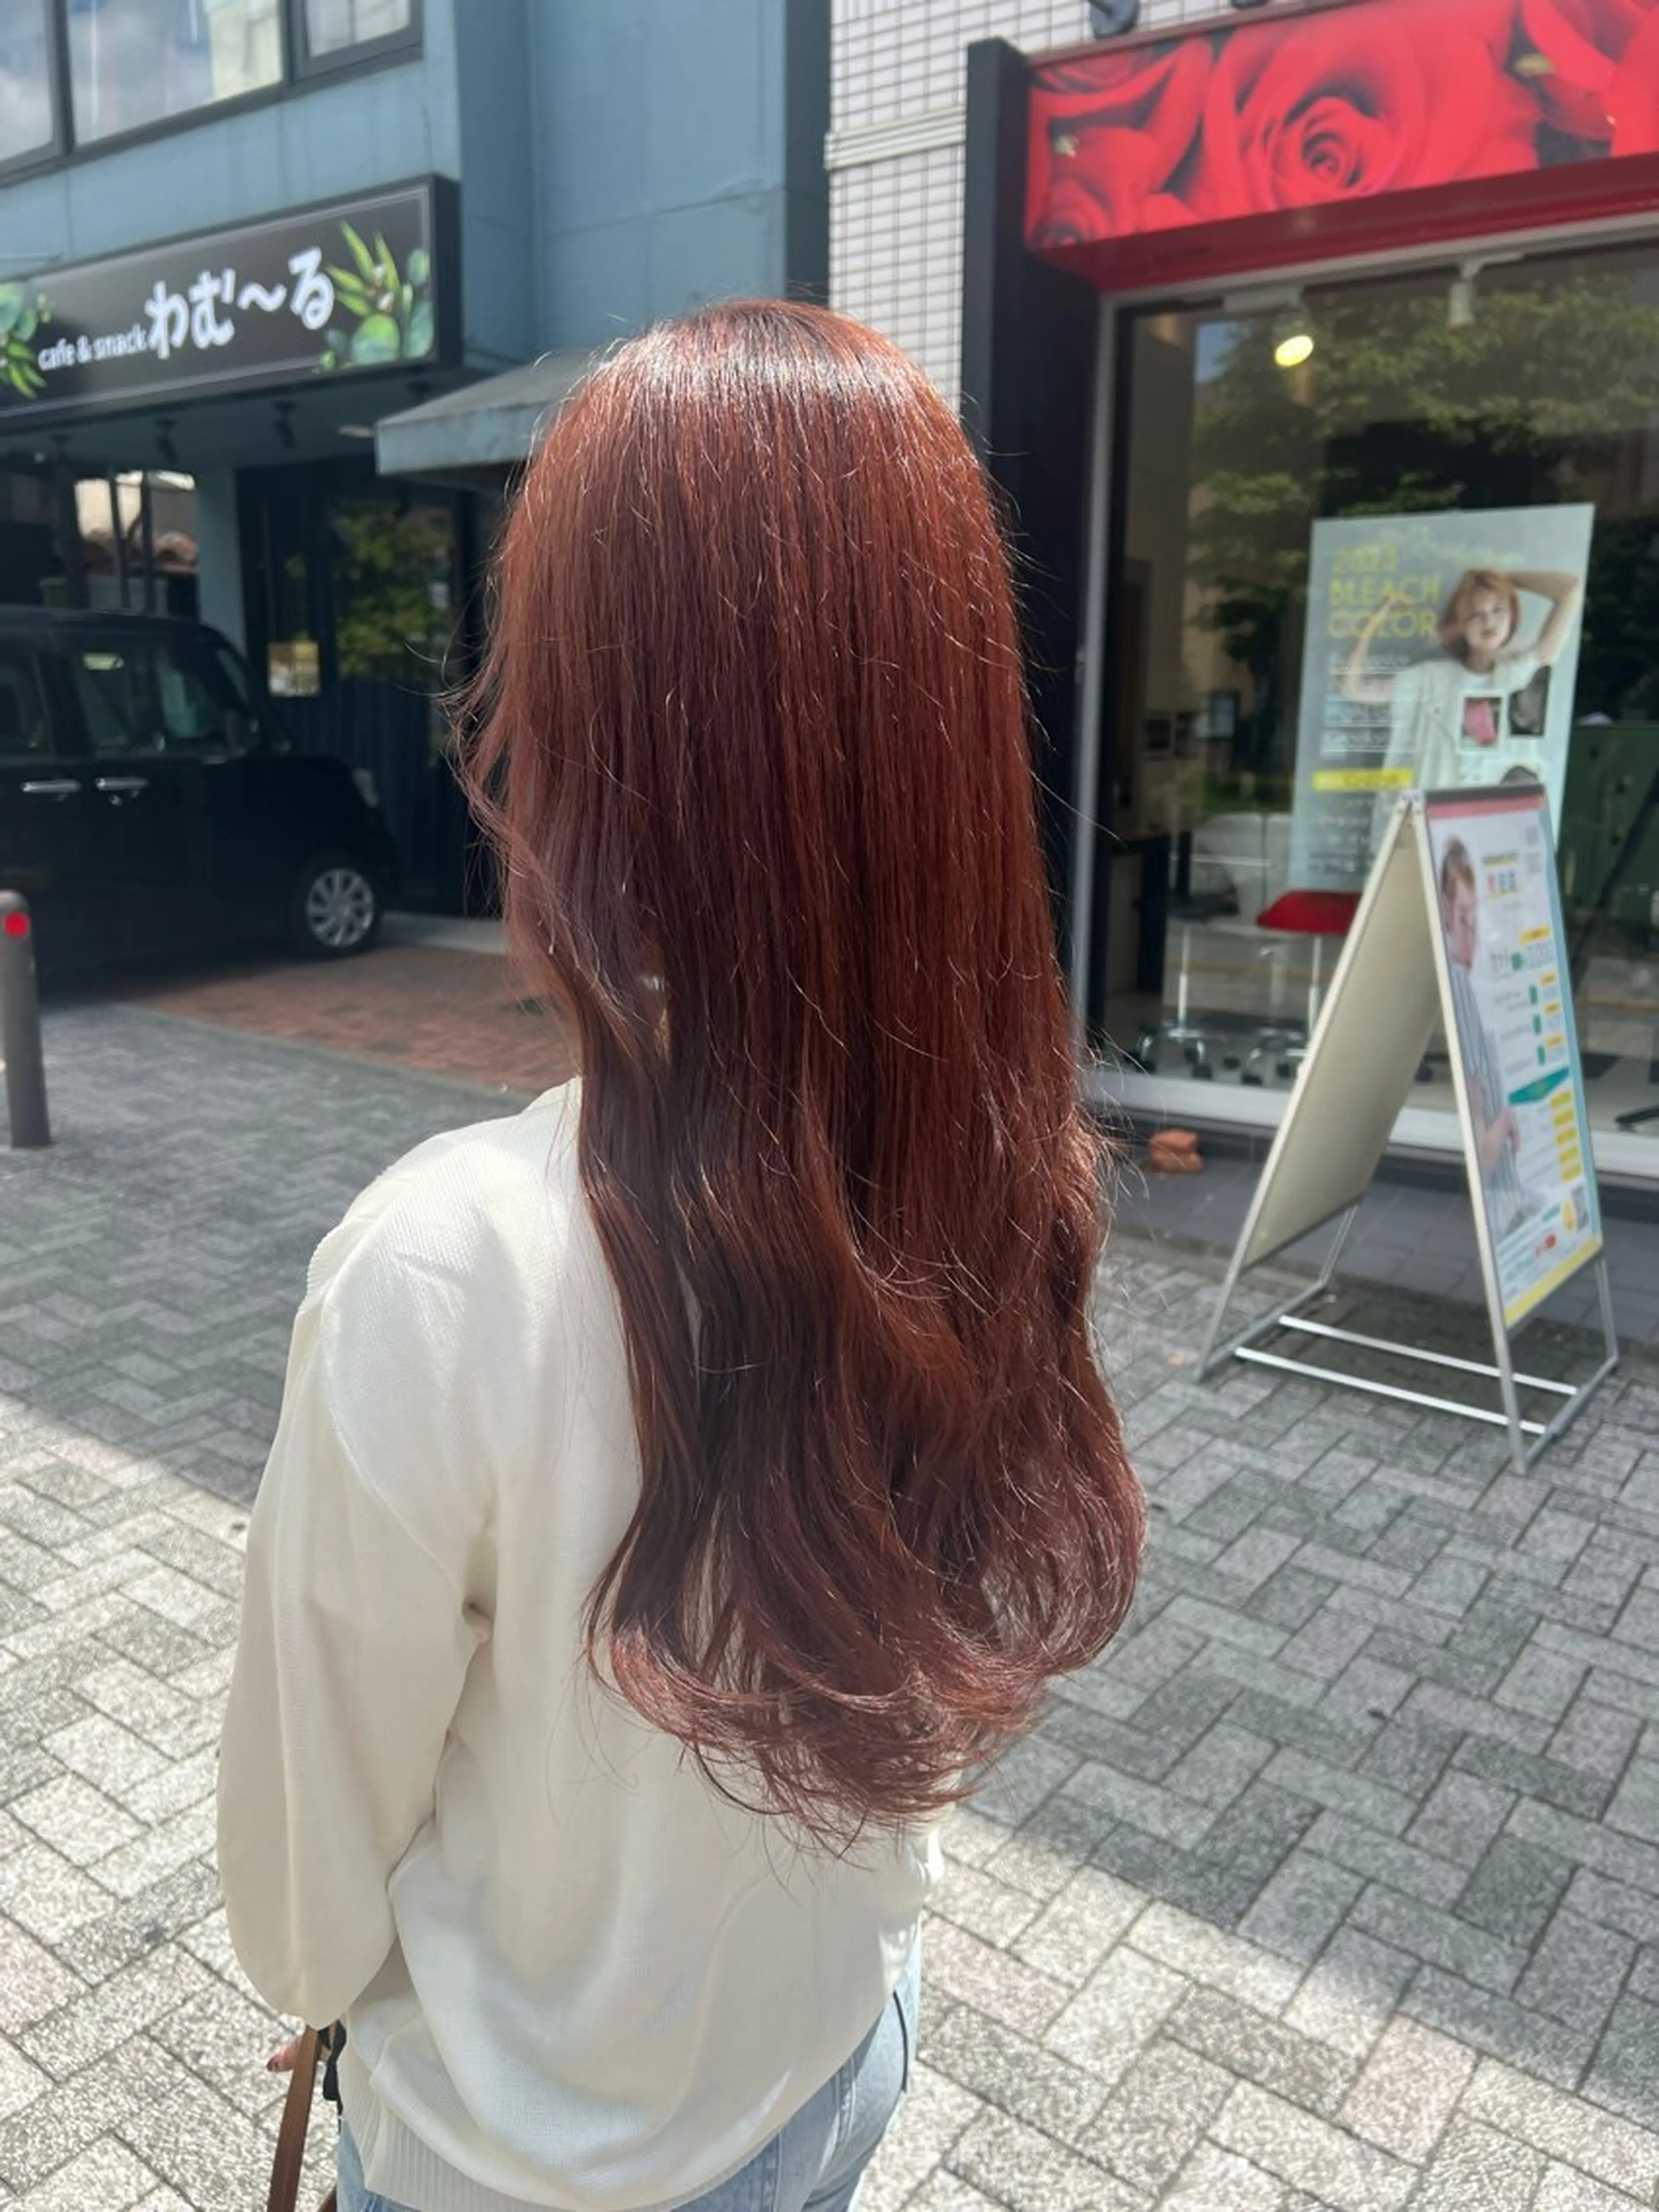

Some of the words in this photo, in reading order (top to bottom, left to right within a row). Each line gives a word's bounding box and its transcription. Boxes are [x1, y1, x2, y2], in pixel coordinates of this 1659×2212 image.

[38, 337, 75, 371] cafe
[76, 335, 92, 363] &
[93, 324, 146, 360] snack
